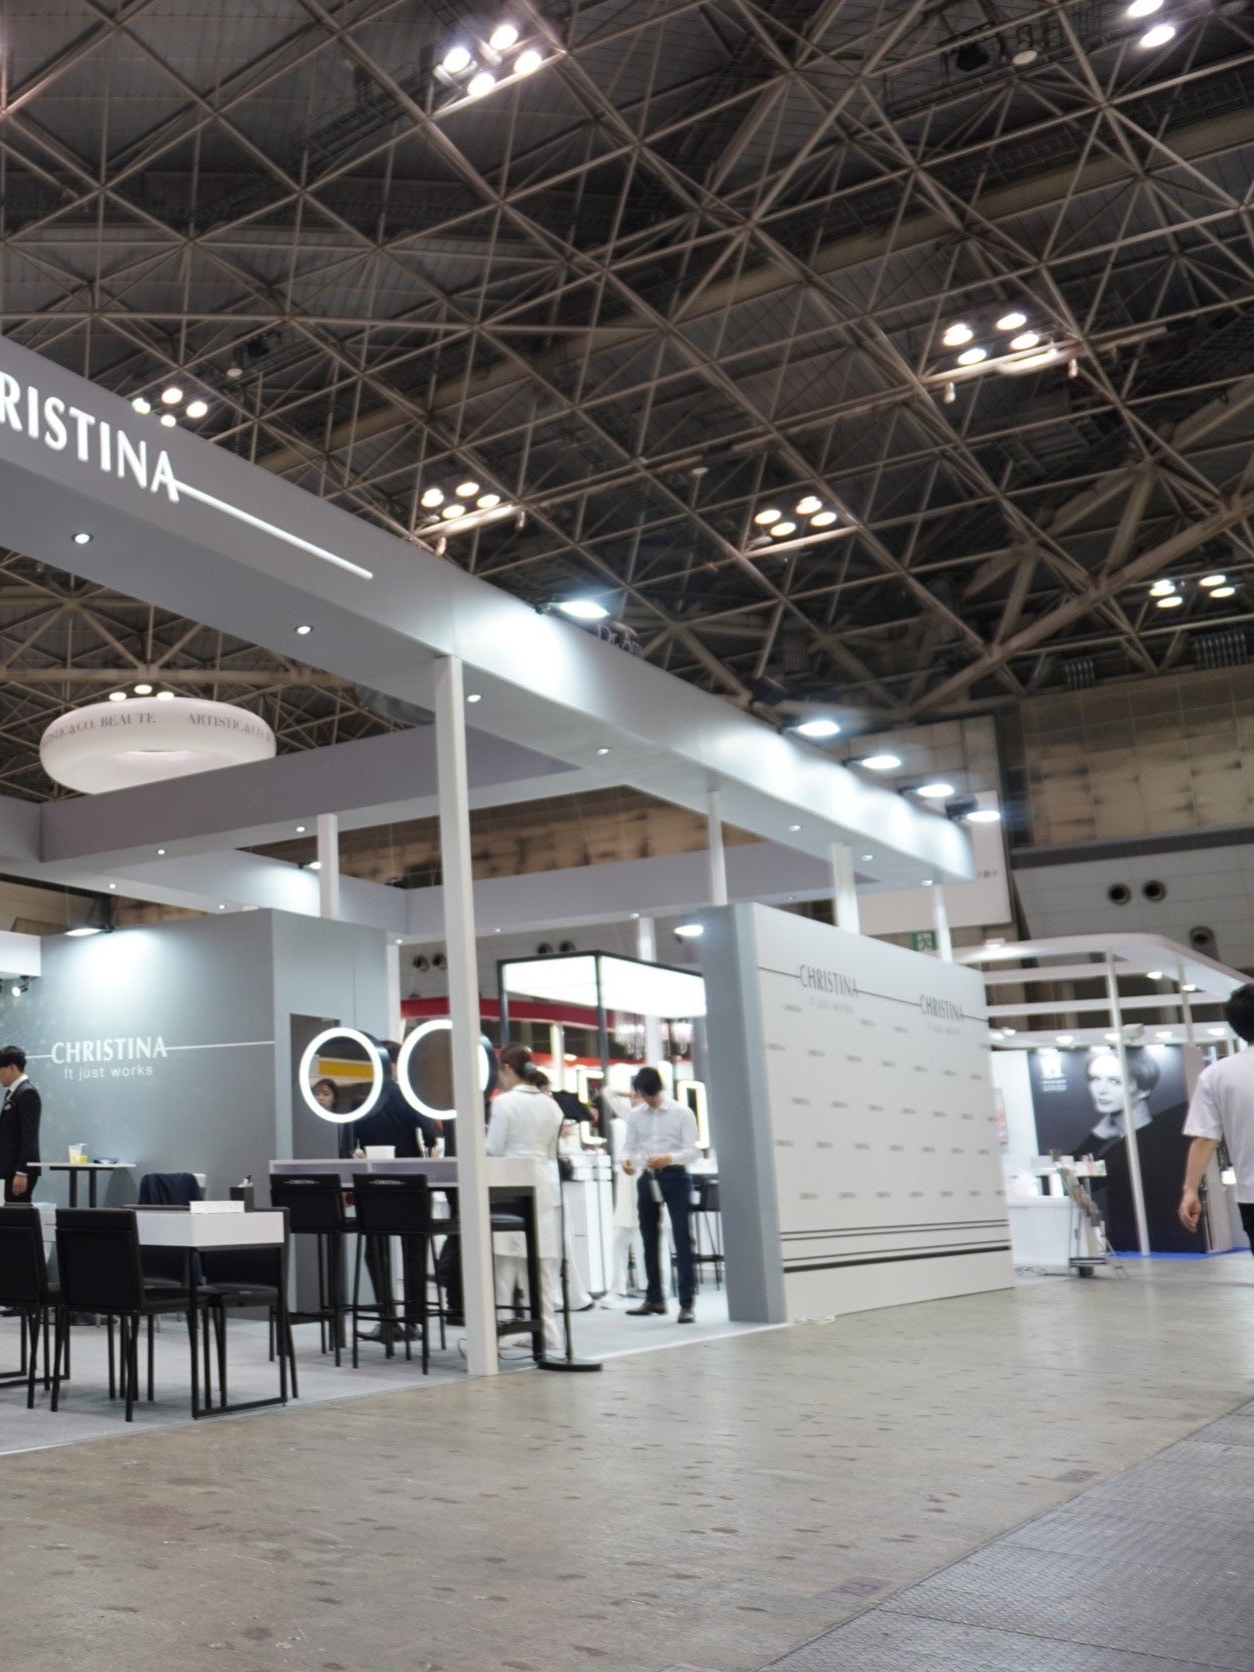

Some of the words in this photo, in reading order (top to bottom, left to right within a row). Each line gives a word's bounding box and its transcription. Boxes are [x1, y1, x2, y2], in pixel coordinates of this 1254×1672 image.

[799, 964, 859, 999] CHRISTINA
[919, 994, 965, 1022] CHRISTINA
[50, 1035, 168, 1064] CHRISTINA
[78, 1067, 104, 1082] just
[110, 1065, 154, 1078] works
